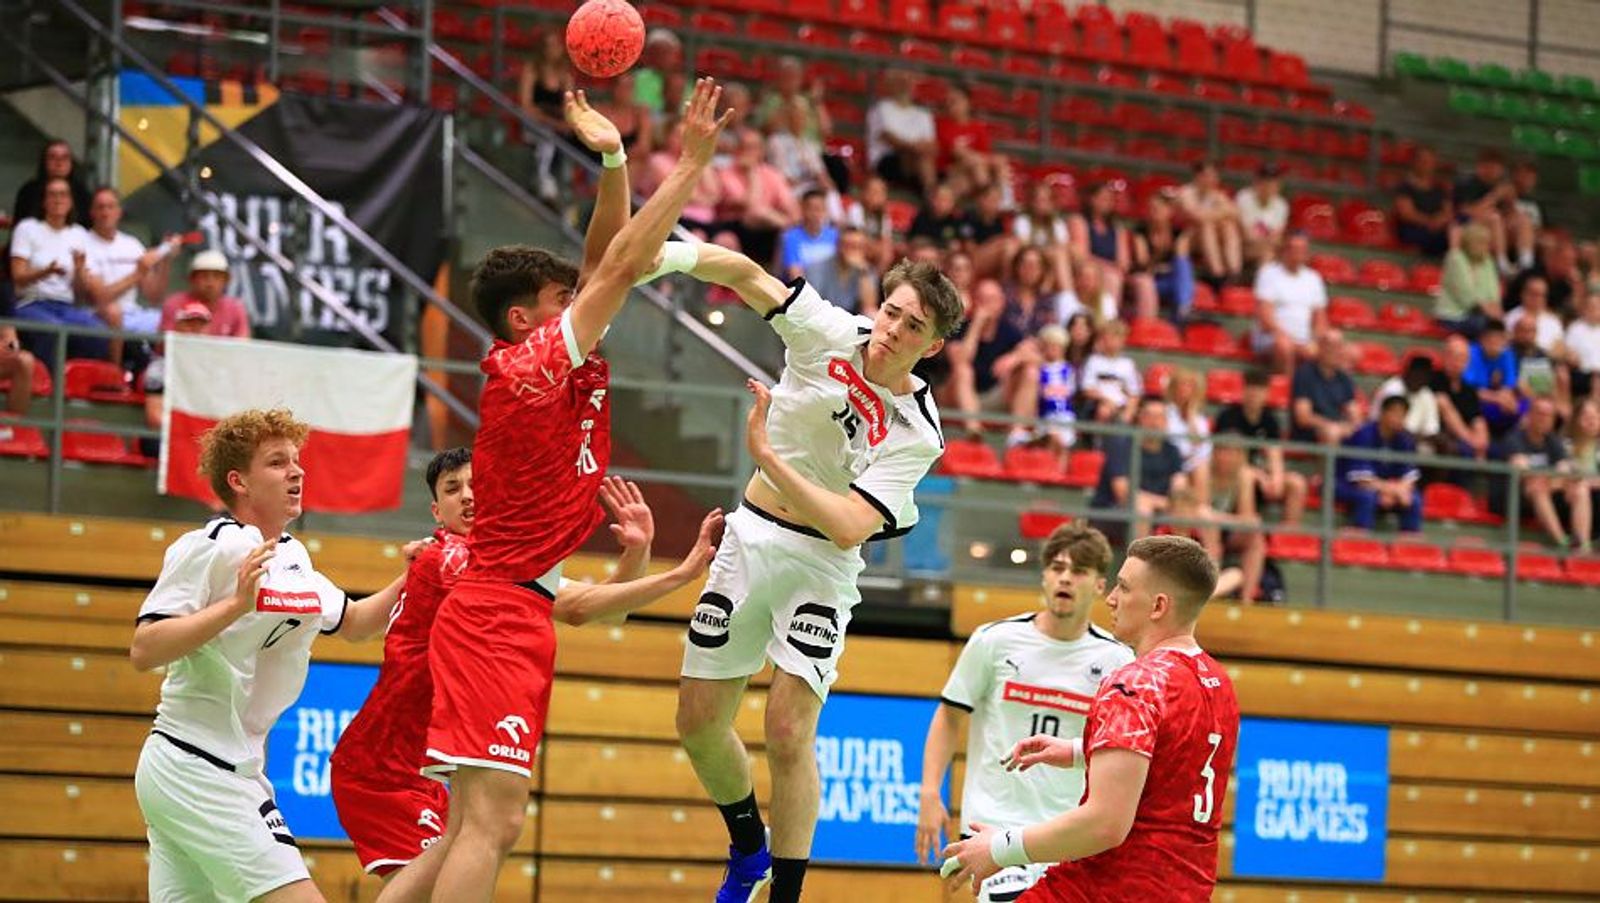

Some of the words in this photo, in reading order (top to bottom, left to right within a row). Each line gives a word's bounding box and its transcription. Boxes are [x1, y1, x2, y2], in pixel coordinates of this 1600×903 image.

[226, 256, 391, 333] AMES
[694, 609, 731, 629] ARTING
[789, 618, 839, 645] HARTING
[488, 744, 530, 763] ORLEN
[1193, 733, 1222, 823] 3
[1256, 757, 1348, 802] RUHR
[1254, 798, 1369, 843] GAMES
